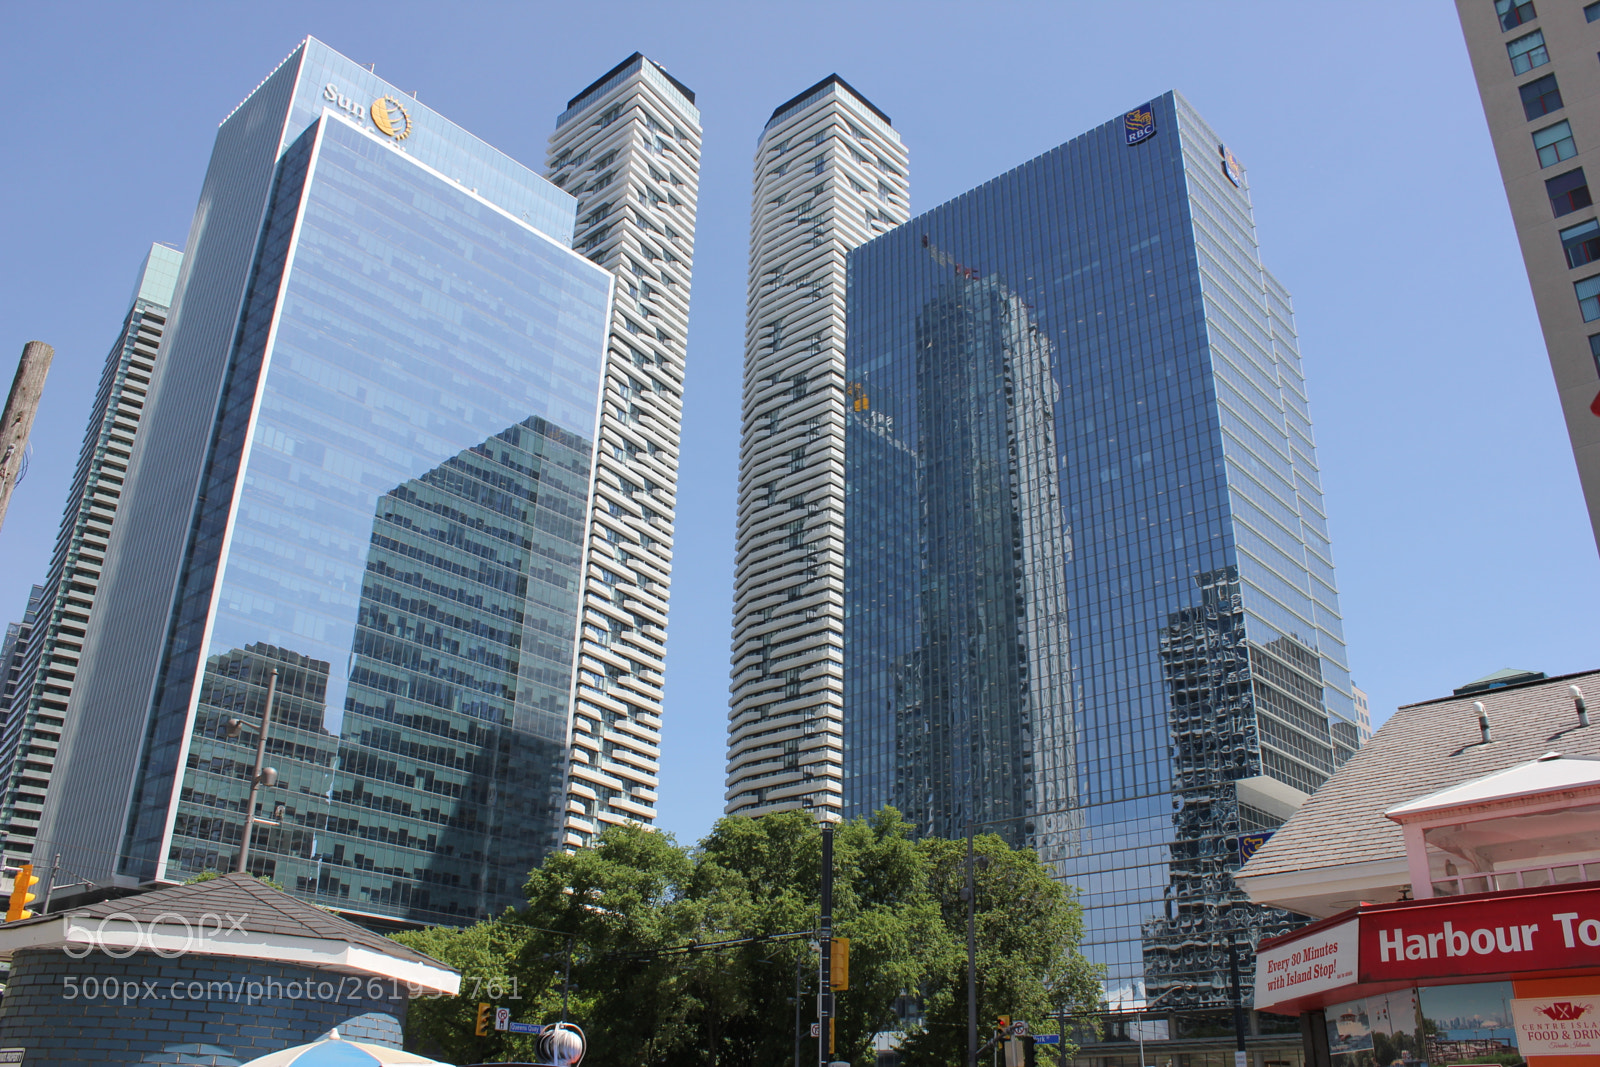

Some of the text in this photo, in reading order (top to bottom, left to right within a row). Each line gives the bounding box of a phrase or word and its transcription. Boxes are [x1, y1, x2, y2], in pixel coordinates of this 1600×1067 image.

[323, 83, 366, 120] Sun
[1128, 126, 1151, 142] RBC
[1379, 912, 1600, 963] Harbour To
[1267, 941, 1339, 974] Every 30 Minutes
[1267, 974, 1285, 992] with
[1286, 966, 1312, 987] Island
[1313, 958, 1337, 980] Stop!
[1521, 1021, 1600, 1031] CENTRE ISLA
[1527, 1030, 1559, 1041] FOOD
[1562, 1030, 1571, 1040] &
